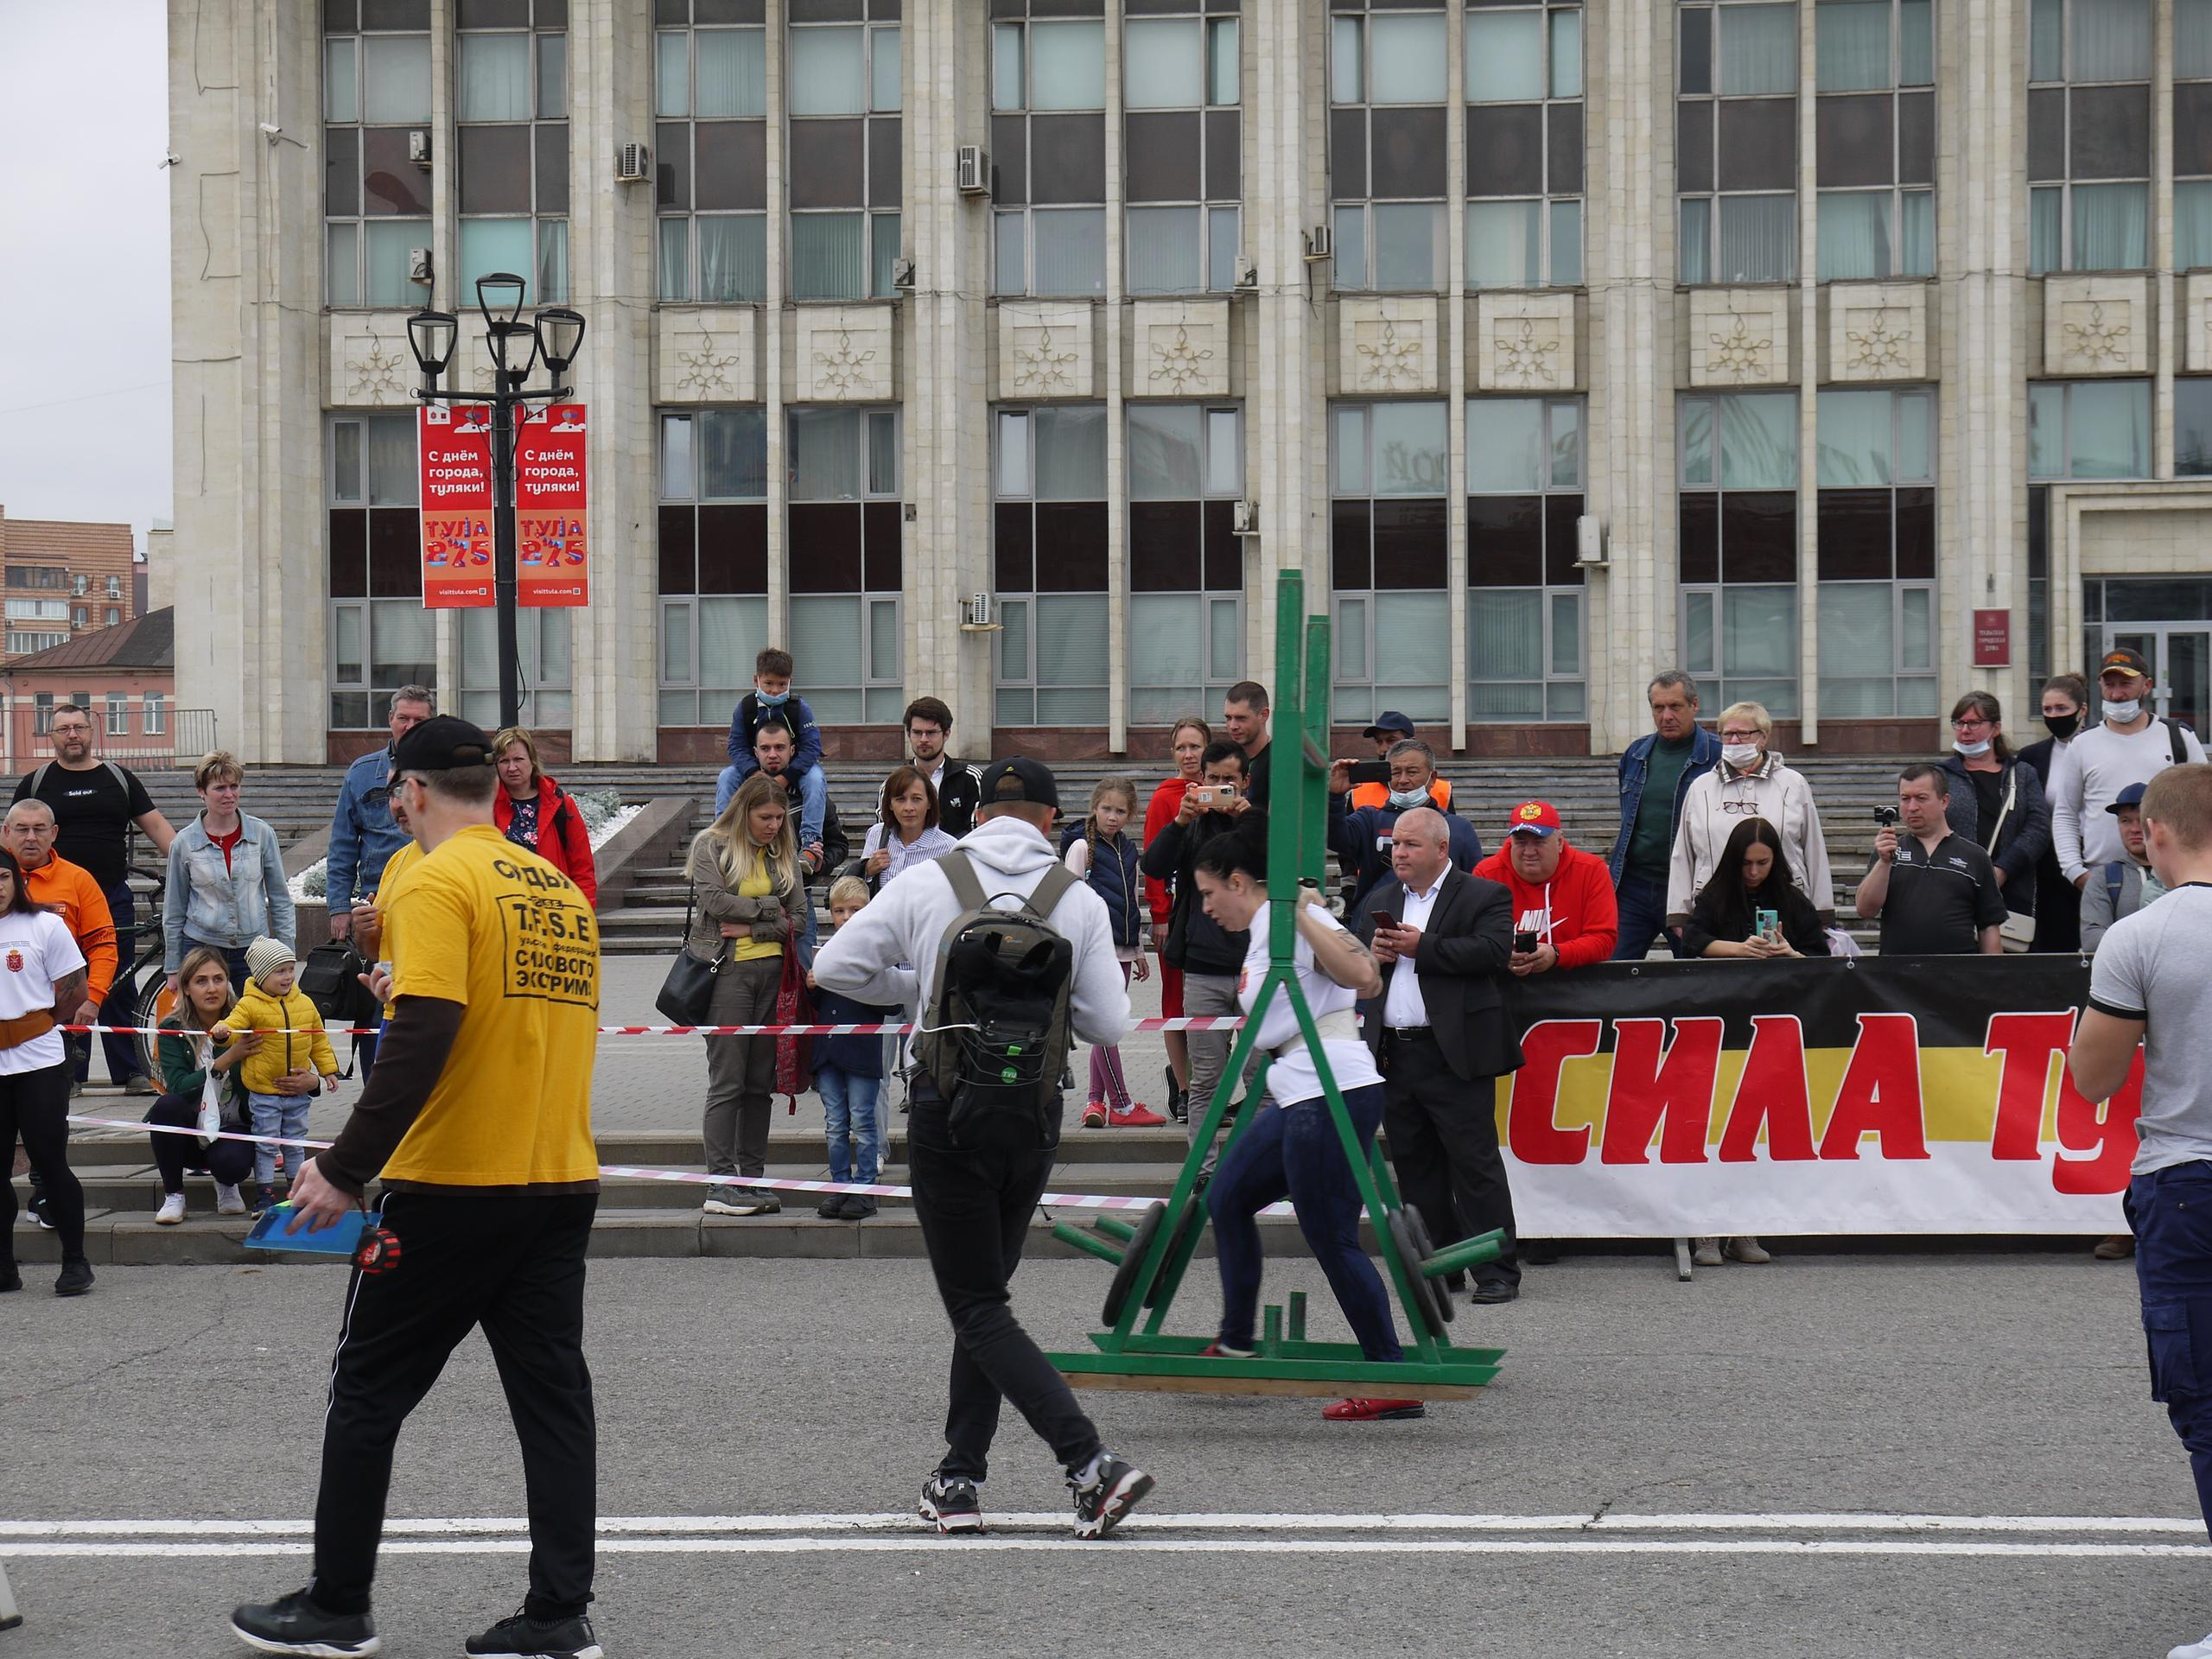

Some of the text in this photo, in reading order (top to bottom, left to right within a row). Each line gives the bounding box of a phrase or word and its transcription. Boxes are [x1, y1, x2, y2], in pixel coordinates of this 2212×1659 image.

[429, 450, 479, 463] С днём
[524, 449, 574, 461] С днём
[429, 467, 484, 480] города,
[524, 467, 579, 479] города,
[429, 481, 485, 496] туляки!
[524, 480, 580, 495] туляки!
[425, 518, 489, 538] ТУЛА
[520, 517, 584, 538] ТУЛА
[425, 538, 490, 567] 875
[520, 537, 585, 567] 875
[1509, 1012, 1932, 1165] СИЛА
